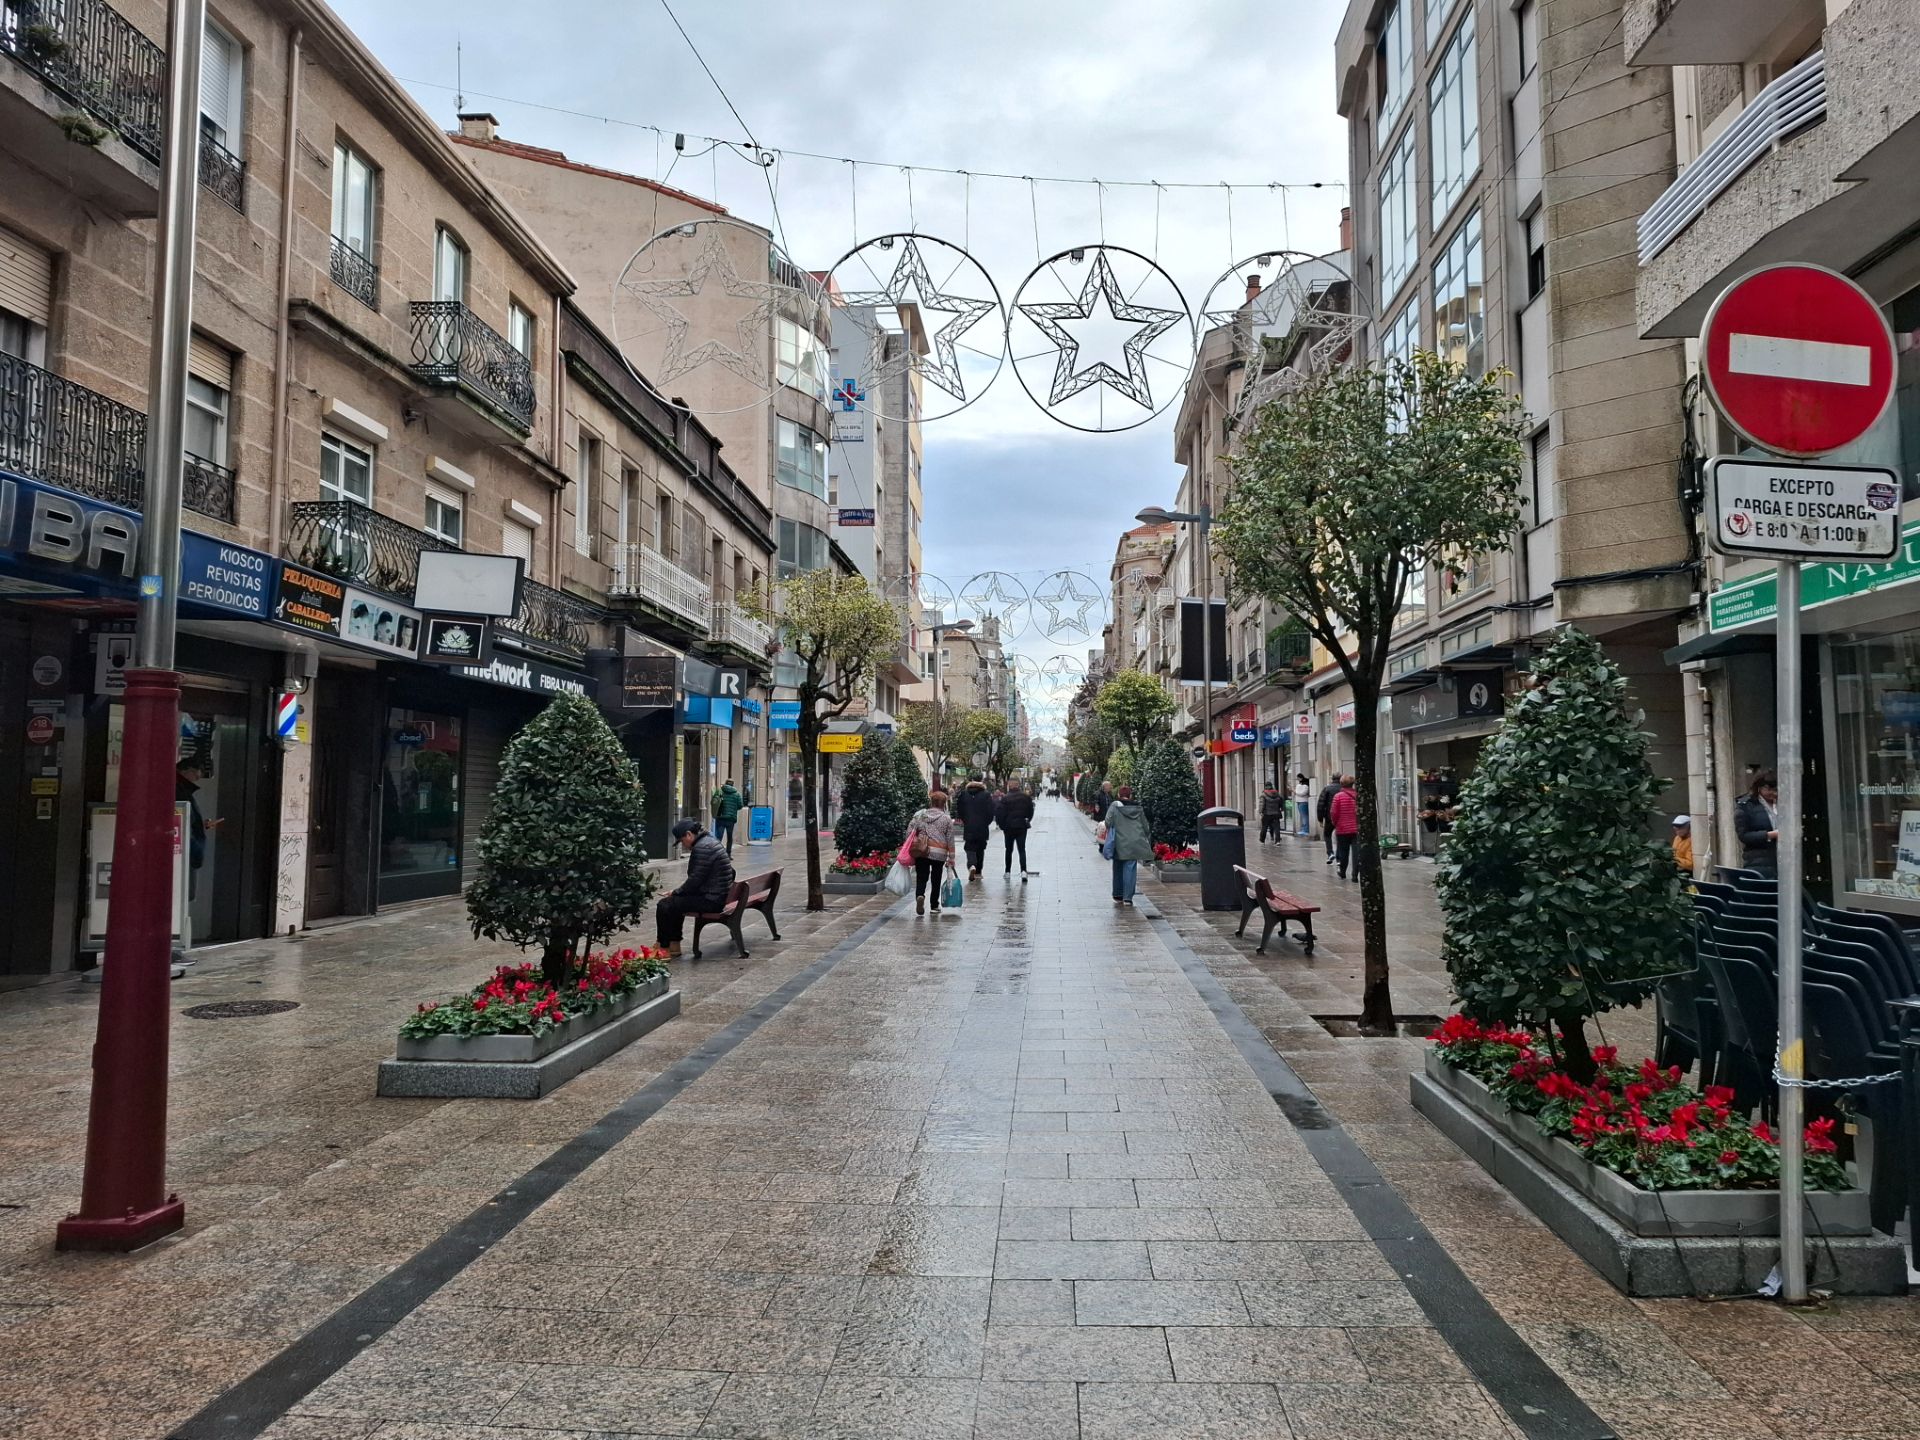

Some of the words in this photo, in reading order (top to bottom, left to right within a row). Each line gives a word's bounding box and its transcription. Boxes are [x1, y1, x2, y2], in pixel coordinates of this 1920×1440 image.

[1769, 477, 1835, 497] EXCEPTO
[1734, 497, 1782, 516] CARGA
[1785, 501, 1794, 517] E
[1797, 502, 1878, 521] DESCARGA
[1799, 525, 1811, 540] A
[1813, 526, 1854, 543] 11:00
[219, 547, 264, 572] KIOSCO
[206, 564, 262, 592] REVISTAS
[187, 581, 260, 611] PERIÓDICOS
[286, 601, 332, 624] CABALLERO
[1716, 600, 1754, 617] PARAFARMACIA
[1716, 611, 1754, 627] TRATAMIENTOS
[1753, 603, 1777, 616] INTEGRA
[539, 674, 560, 691] FIBRA
[720, 672, 740, 695] R
[1234, 731, 1255, 740] bed's
